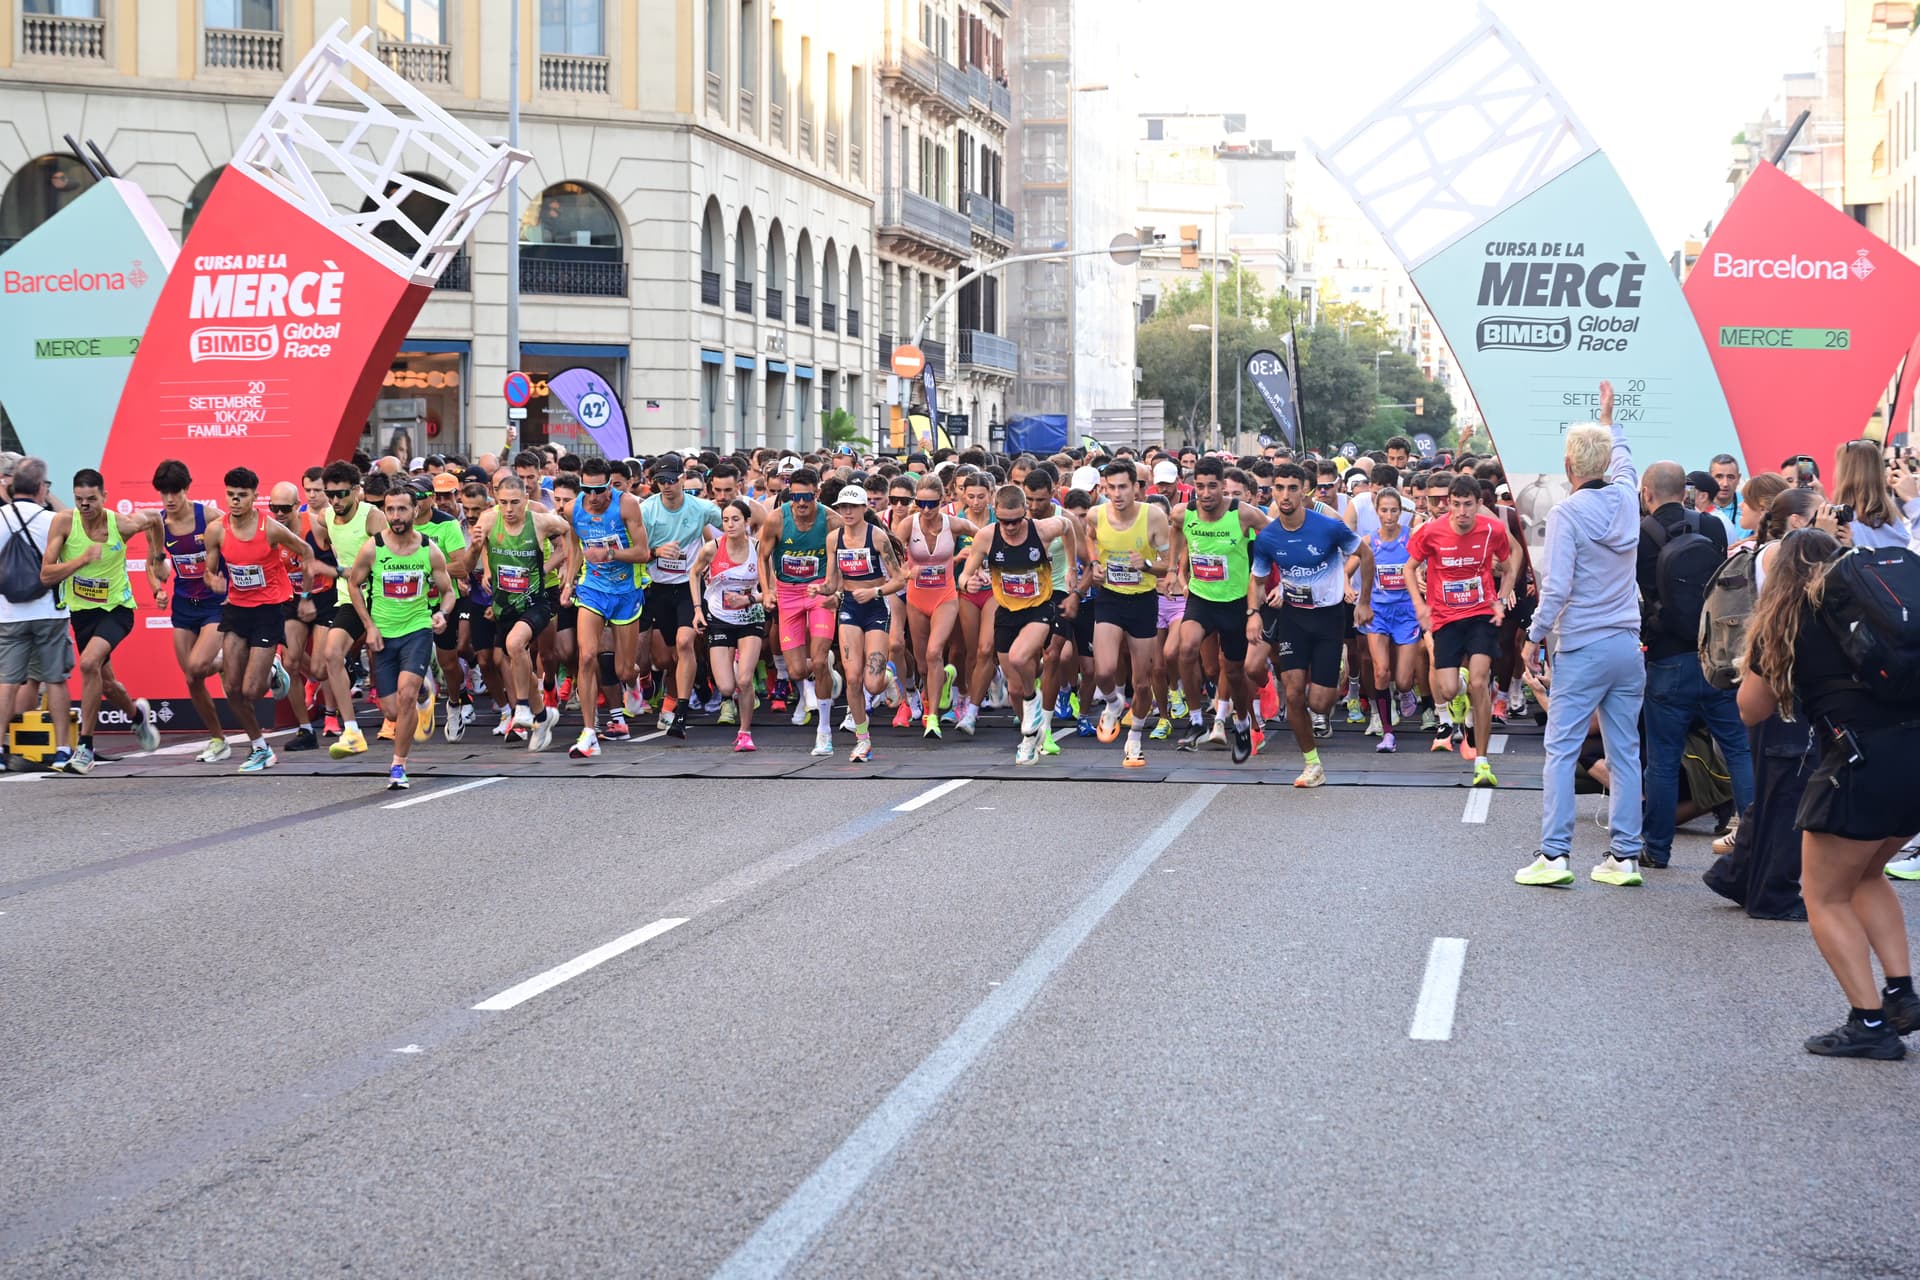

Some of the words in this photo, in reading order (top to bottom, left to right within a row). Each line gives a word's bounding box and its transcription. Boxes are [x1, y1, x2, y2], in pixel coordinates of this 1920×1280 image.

[1485, 241, 1537, 257] CURSA
[1541, 243, 1562, 257] DE
[1565, 243, 1585, 257] LA
[194, 255, 243, 271] CURSA
[246, 254, 266, 269] DE
[268, 253, 287, 268] LA
[1713, 252, 1848, 280] Barcelona
[4, 267, 125, 294] Barcelona
[1476, 251, 1647, 308] MERCÈ
[189, 260, 345, 319] MERCÈ
[283, 322, 341, 340] Global
[1577, 315, 1640, 333] Global
[1483, 324, 1566, 344] BIMBO
[1825, 331, 1849, 348] 26
[129, 338, 140, 354] 2
[198, 334, 272, 353] BIMBO
[283, 341, 331, 358] Race
[1577, 335, 1628, 351] Race
[248, 381, 266, 394] 20
[1628, 379, 1646, 392] 20
[189, 395, 262, 409] SETEMBRE
[1562, 393, 1642, 407] SETEBRE
[214, 409, 266, 422] 10K/2K/
[1590, 408, 1645, 421] 10/2K/
[187, 424, 248, 437] FAMILIAR
[395, 585, 408, 594] 30
